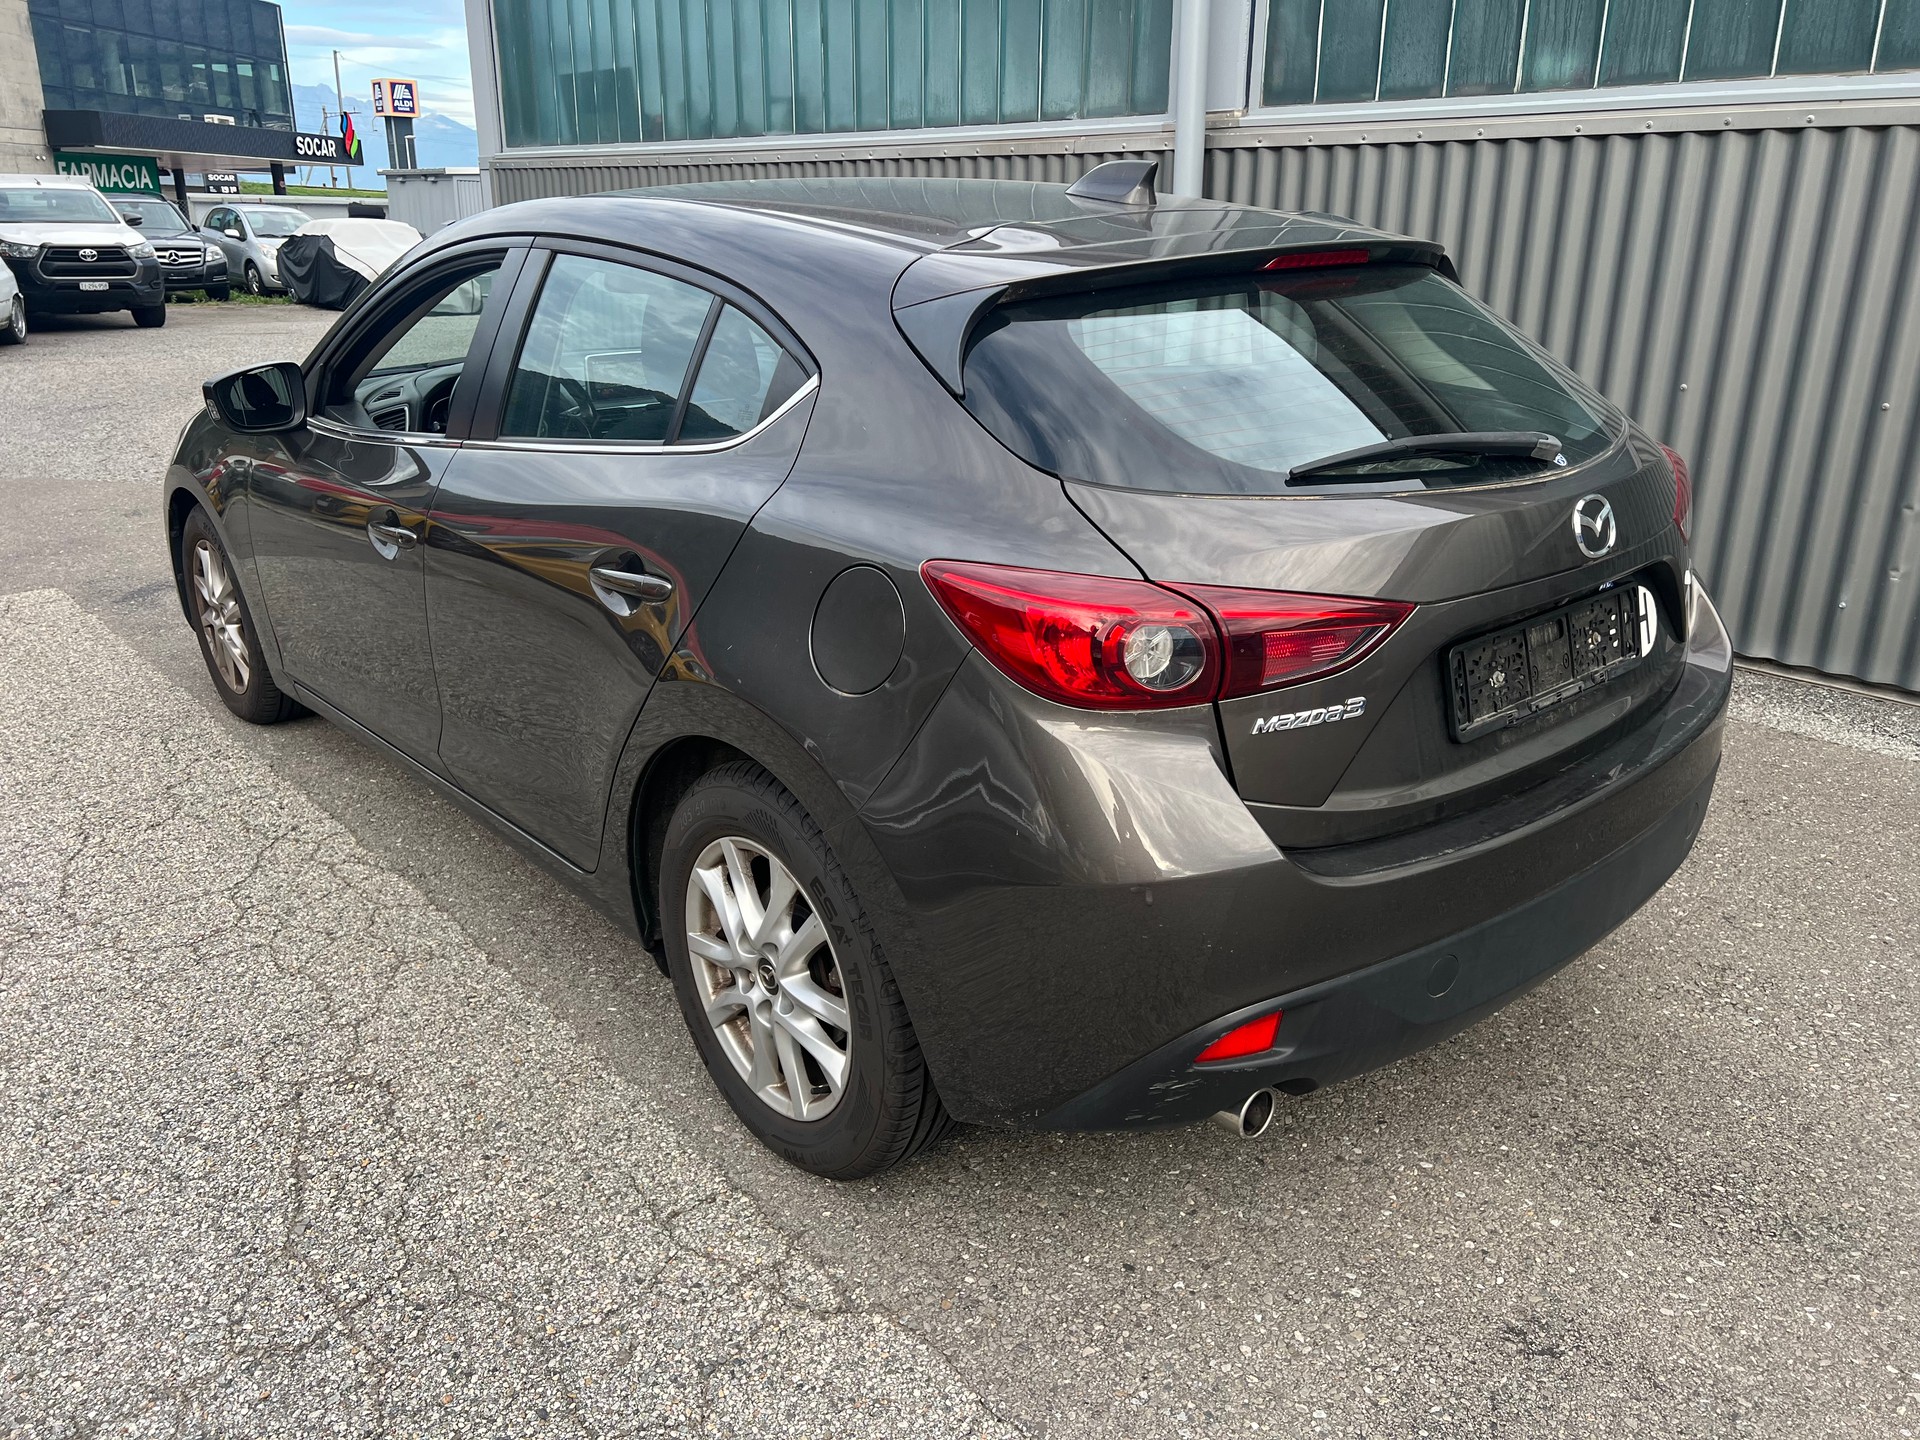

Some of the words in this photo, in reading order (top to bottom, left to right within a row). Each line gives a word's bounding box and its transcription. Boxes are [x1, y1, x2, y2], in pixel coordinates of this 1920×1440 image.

[394, 99, 413, 107] ALDI
[296, 136, 336, 157] SOCAR
[58, 161, 154, 189] FARMACIA
[207, 173, 236, 182] SOCAR
